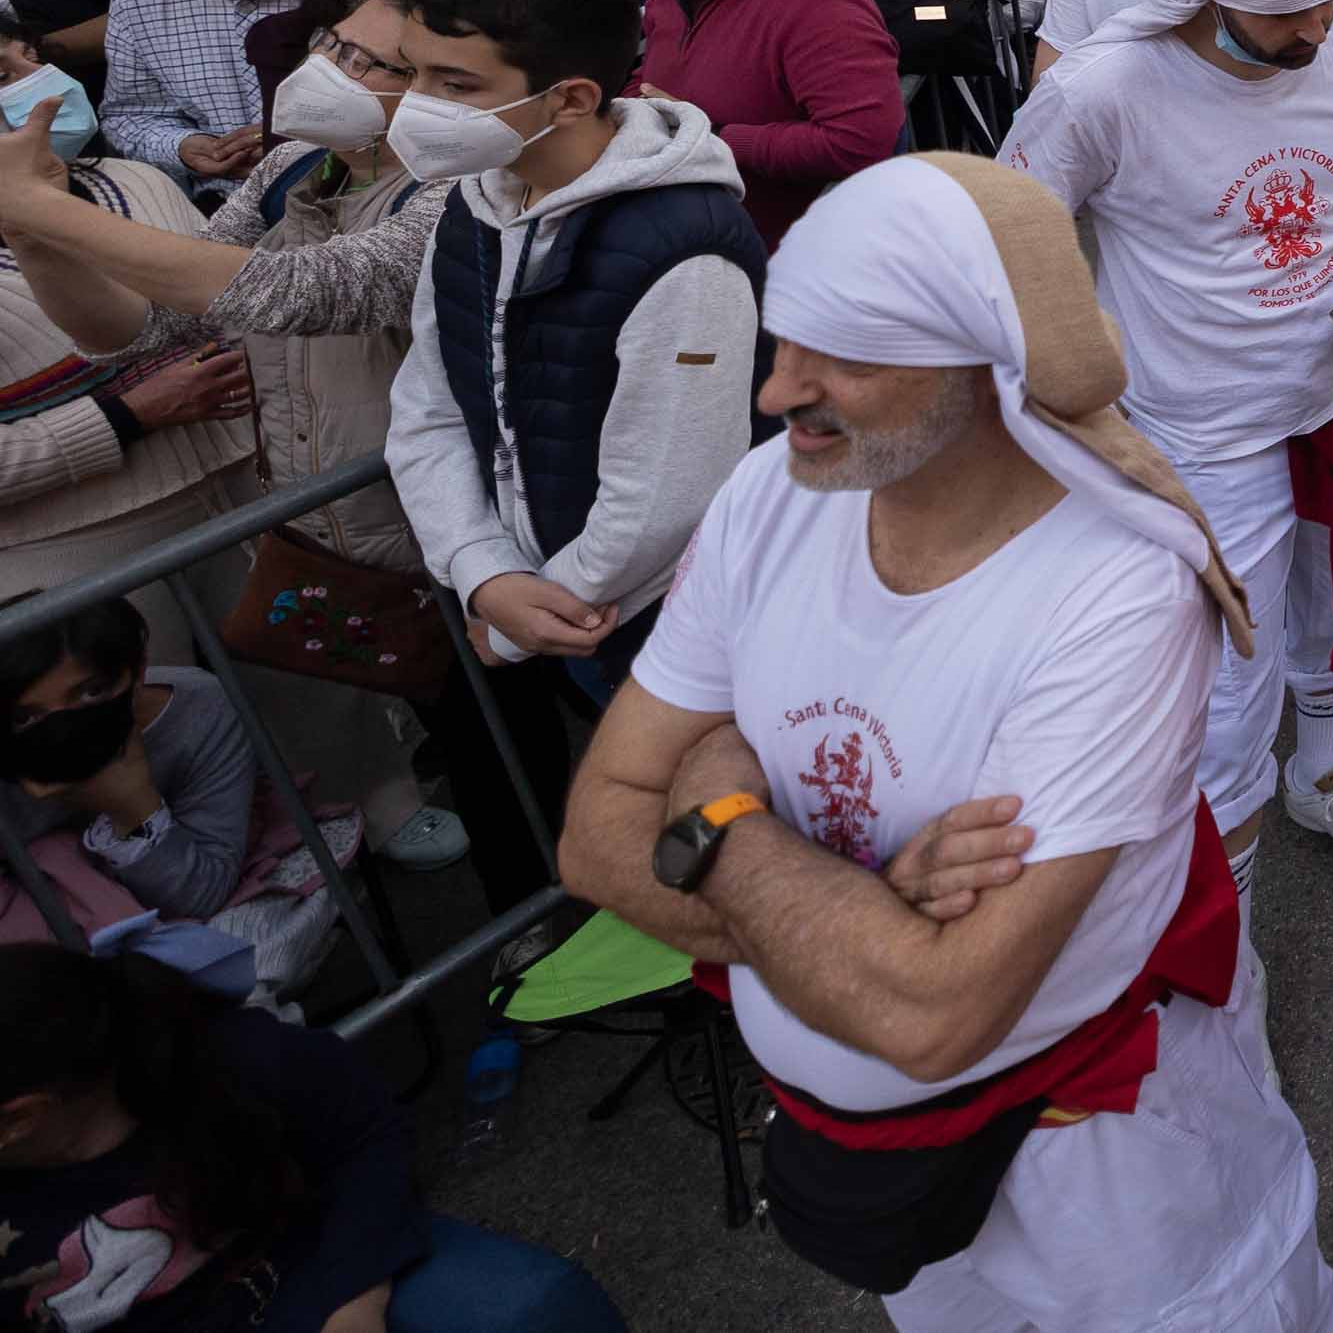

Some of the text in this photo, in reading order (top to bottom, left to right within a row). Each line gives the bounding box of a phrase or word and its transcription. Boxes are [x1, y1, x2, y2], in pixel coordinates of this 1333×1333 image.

[1213, 178, 1247, 219] SANTA
[1243, 152, 1277, 179] CENA
[1278, 147, 1287, 160] Y
[1287, 270, 1308, 284] 1979
[1247, 287, 1269, 298] POR
[1271, 287, 1291, 298] LOS
[1292, 280, 1313, 295] QUE
[1259, 297, 1295, 308] SOMOS
[833, 697, 868, 723] Cena
[871, 718, 903, 780] Victoria
